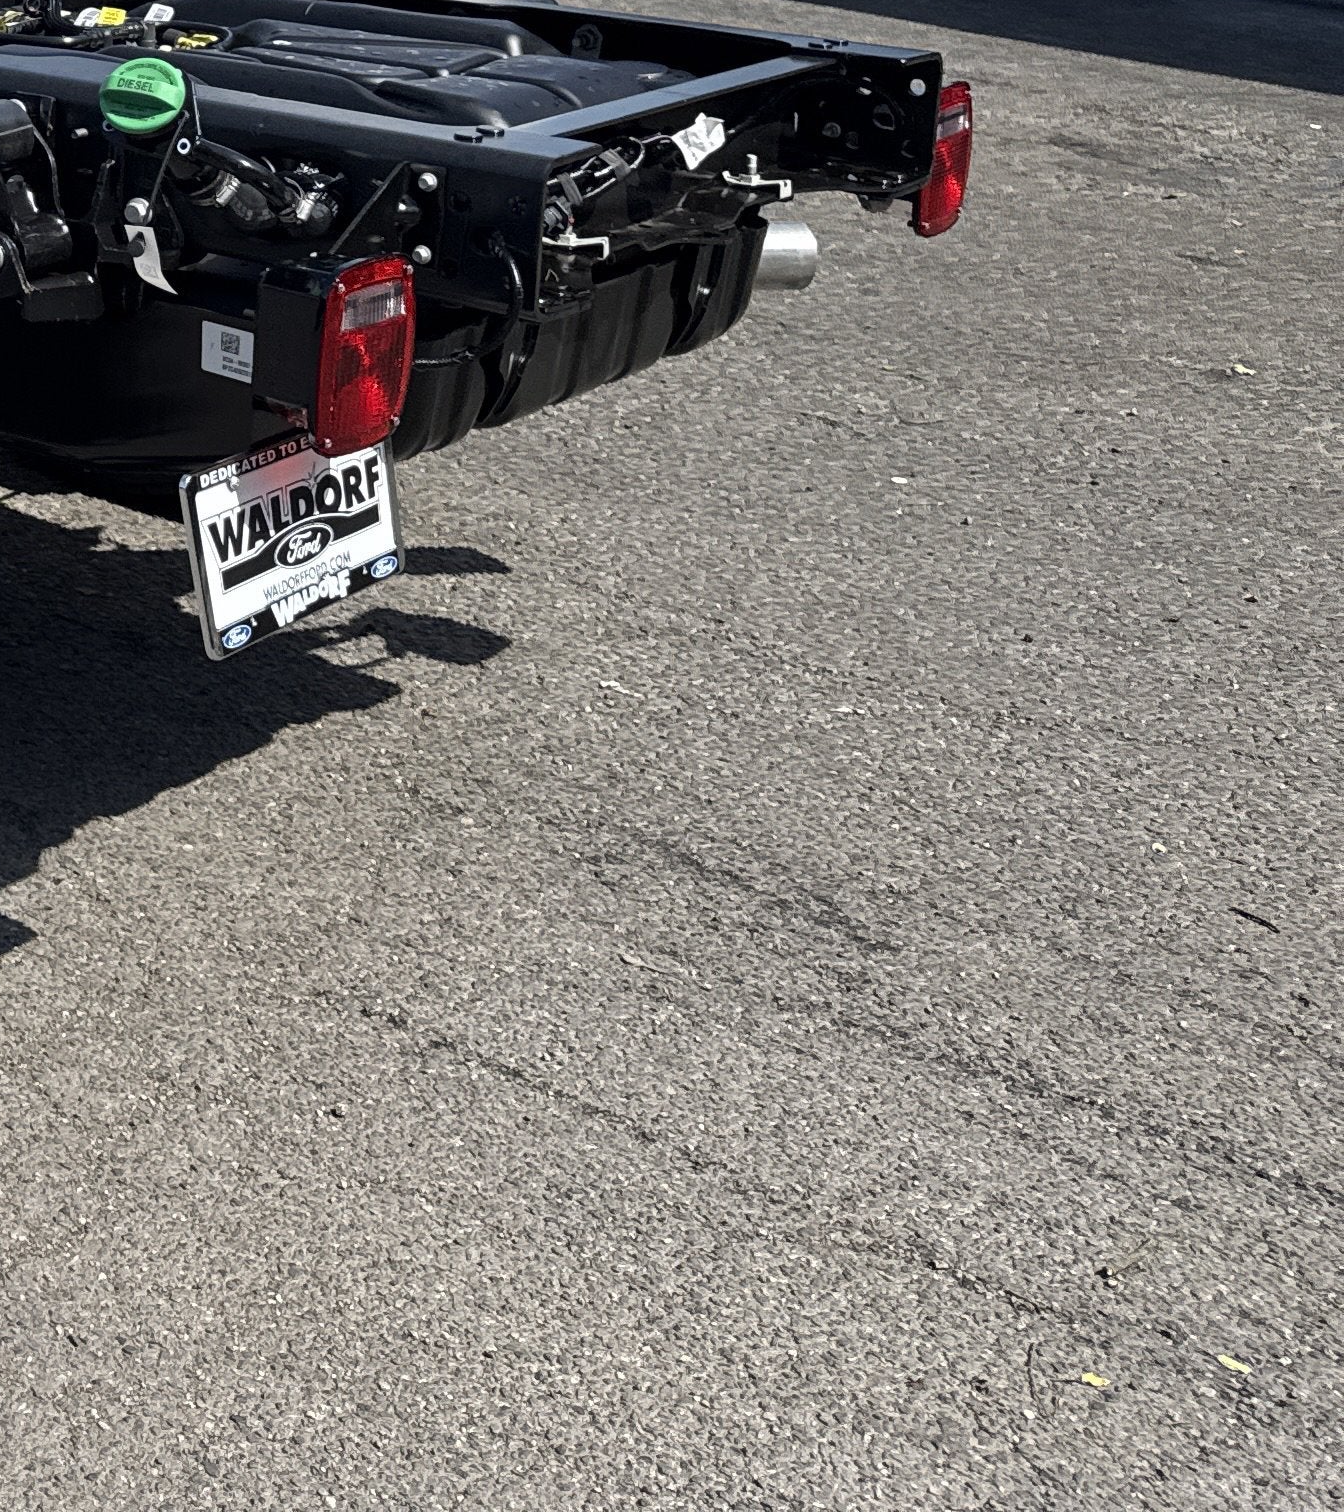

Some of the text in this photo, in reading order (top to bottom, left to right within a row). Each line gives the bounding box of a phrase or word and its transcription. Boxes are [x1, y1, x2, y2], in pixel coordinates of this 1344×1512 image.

[117, 77, 154, 93] DIESEL
[200, 448, 276, 488] DEDICATED
[278, 441, 297, 457] TO
[207, 454, 380, 564] WALDORF
[286, 530, 322, 564] Ford
[270, 569, 352, 627] WALDORF
